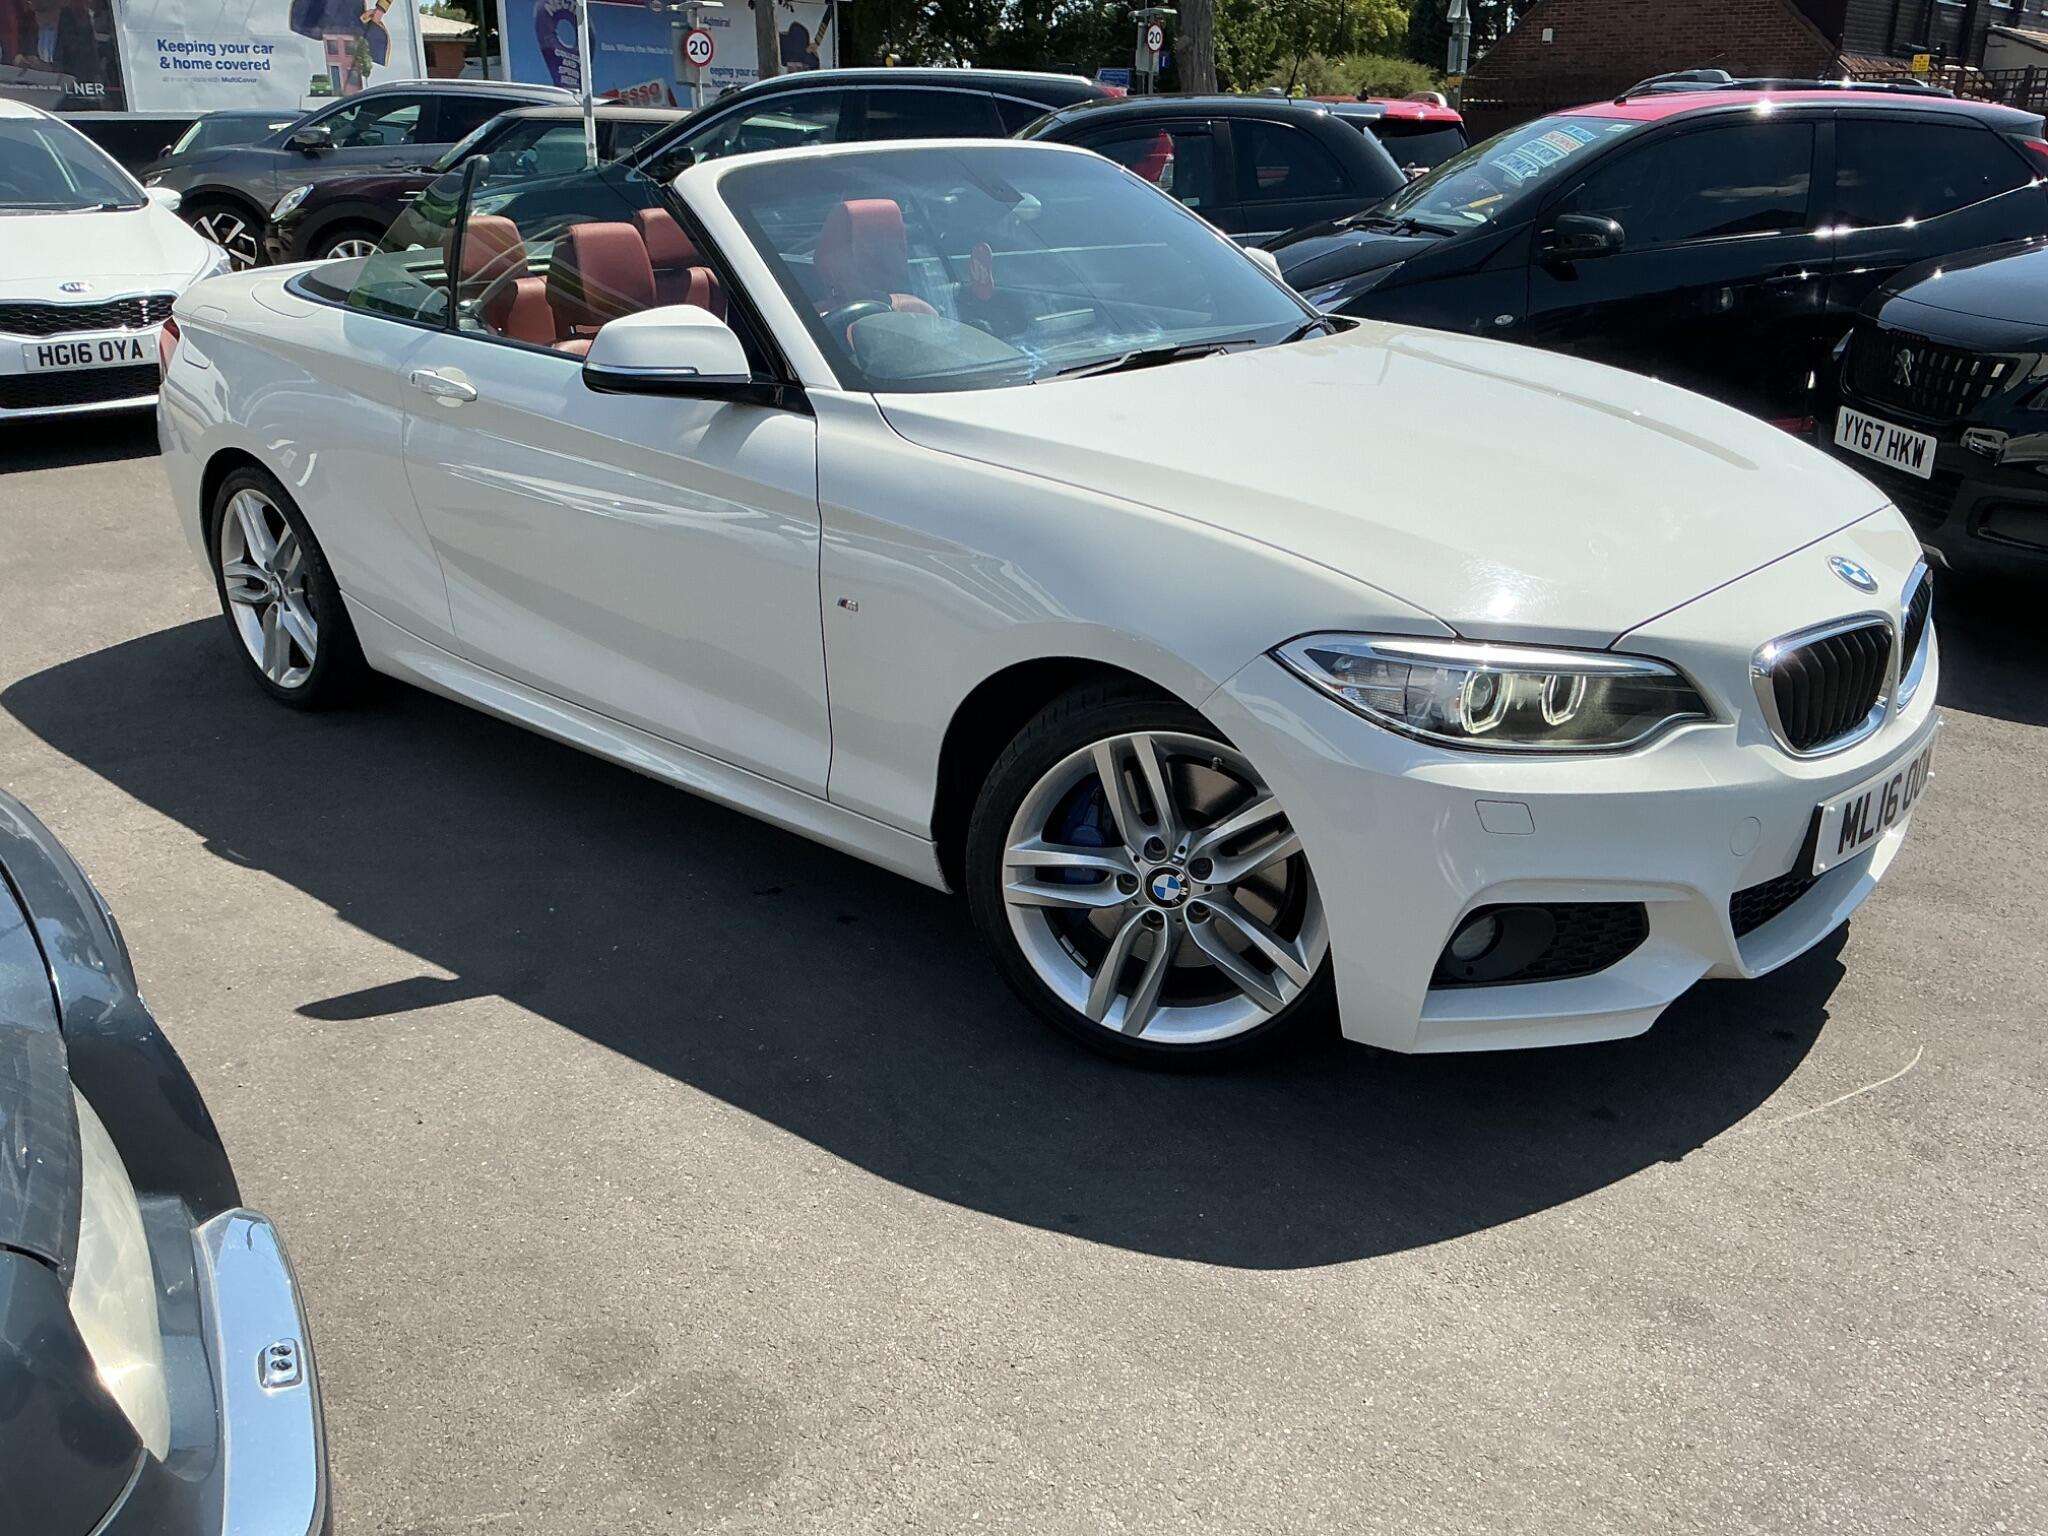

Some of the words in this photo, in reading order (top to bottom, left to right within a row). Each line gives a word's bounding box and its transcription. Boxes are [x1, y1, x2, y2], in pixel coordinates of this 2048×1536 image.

[1149, 31, 1161, 44] 20
[157, 39, 216, 56] Keeping
[219, 43, 250, 56] your
[253, 44, 274, 54] car
[689, 40, 709, 56] 20
[160, 57, 170, 69] &
[173, 57, 213, 70] home
[215, 59, 271, 70] covered
[710, 67, 734, 78] eeping
[65, 80, 105, 96] LNER
[37, 343, 93, 367] HG16
[100, 339, 144, 362] OYA
[1843, 413, 1884, 454] YY67
[1888, 429, 1927, 470] HKW
[1837, 773, 1902, 854] ML16
[1170, 873, 1188, 905] BMW
